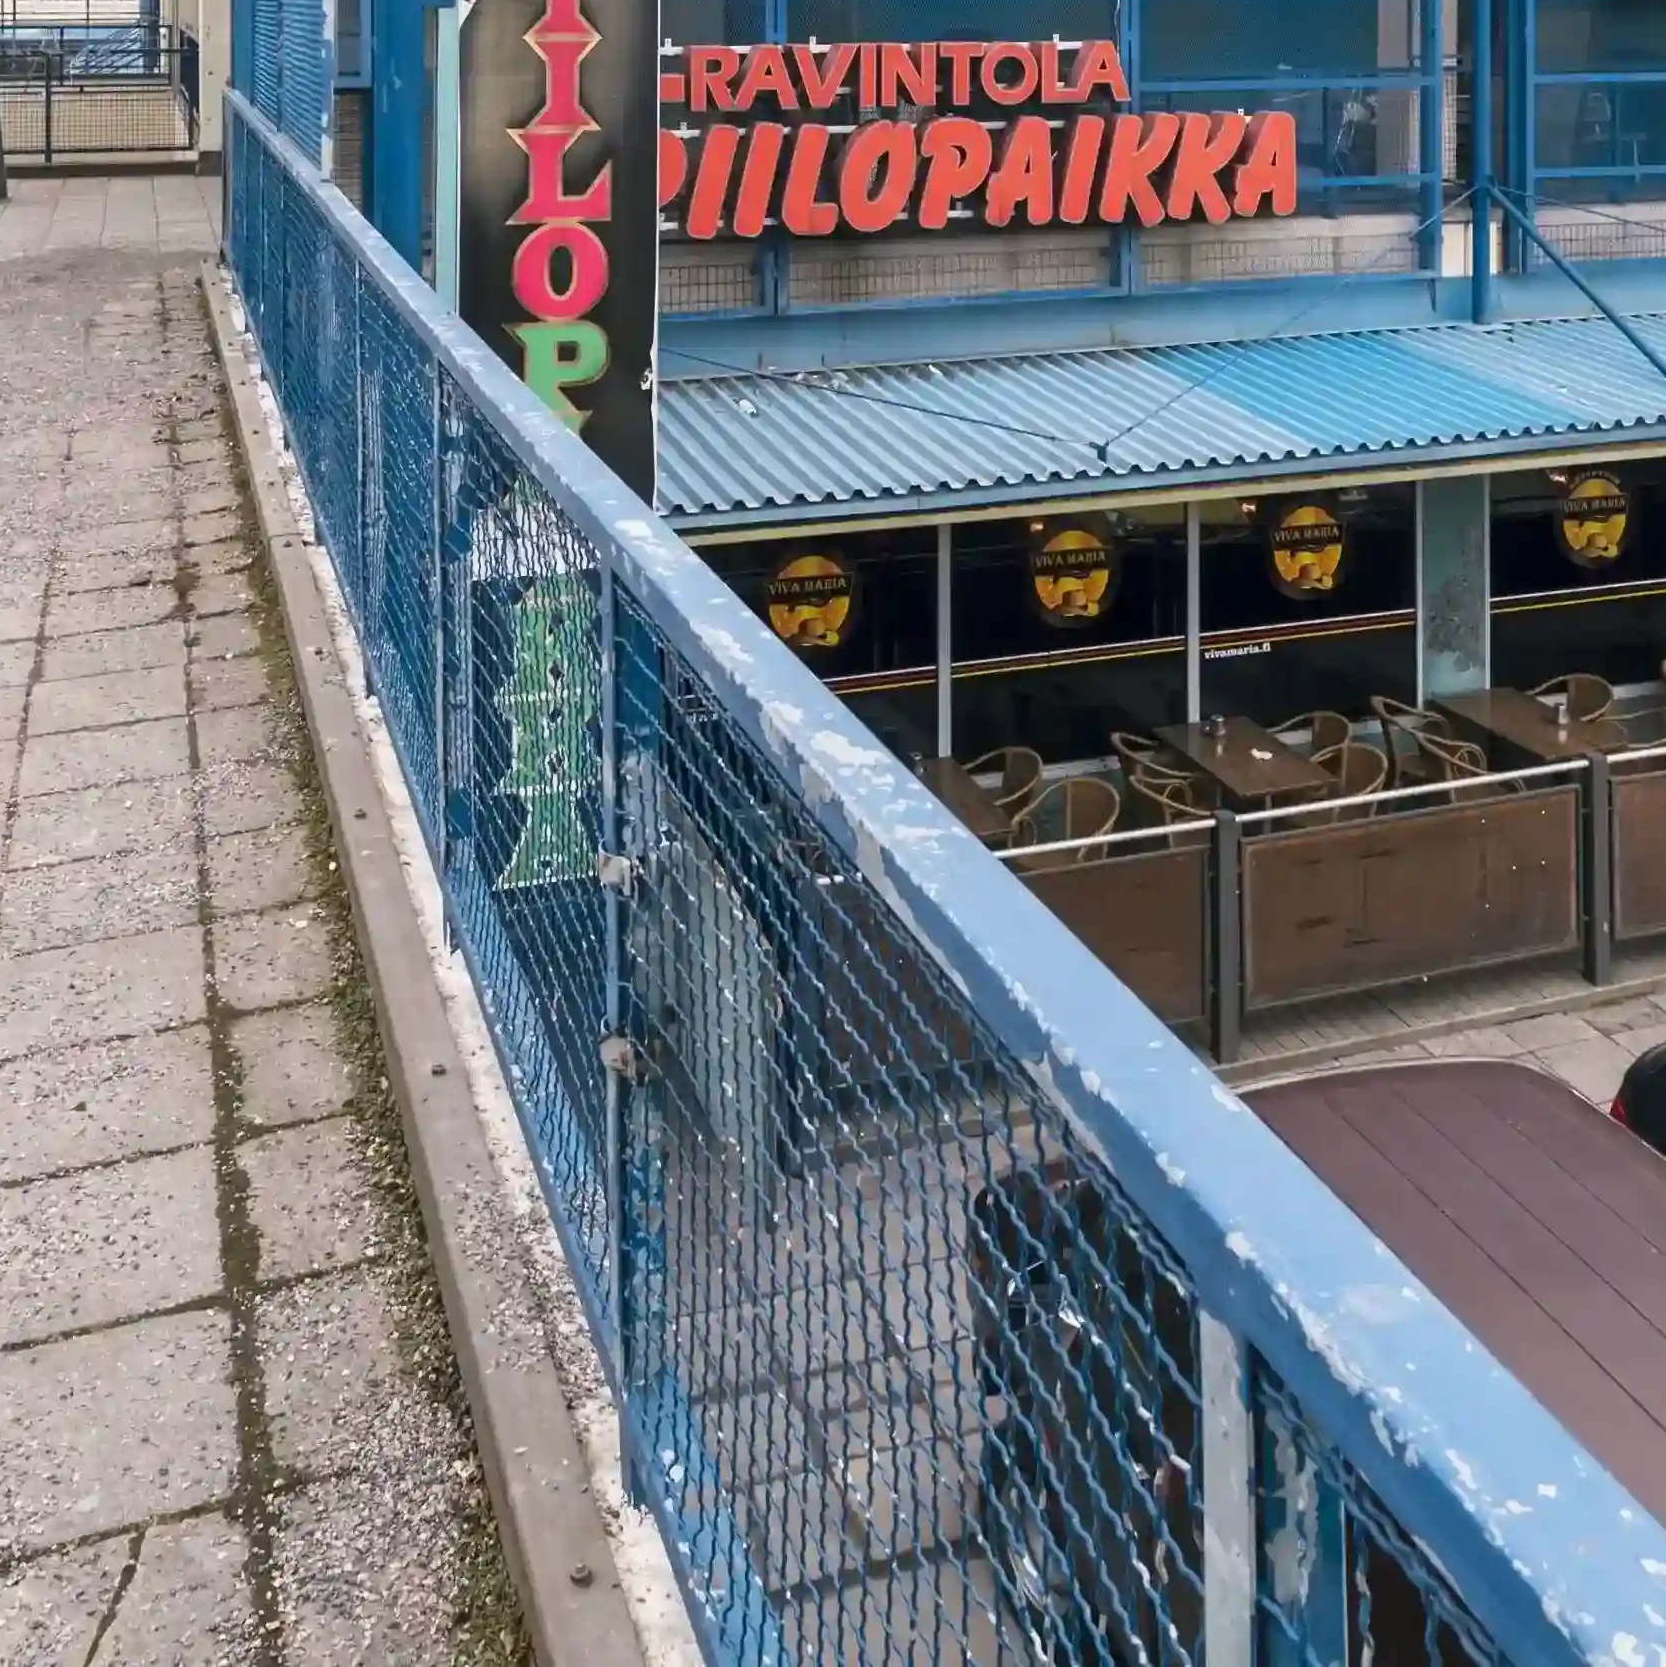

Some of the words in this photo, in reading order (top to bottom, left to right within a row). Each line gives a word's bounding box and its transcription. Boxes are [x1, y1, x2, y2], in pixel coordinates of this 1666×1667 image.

[1274, 529, 1301, 543] VIVA
[1303, 525, 1340, 540] MARIA
[1034, 552, 1065, 568] VIVA
[1067, 548, 1107, 564] MARIA
[769, 581, 800, 595] VIVA
[804, 577, 846, 592] MARIA
[1204, 642, 1271, 659] vivamaria.fi
